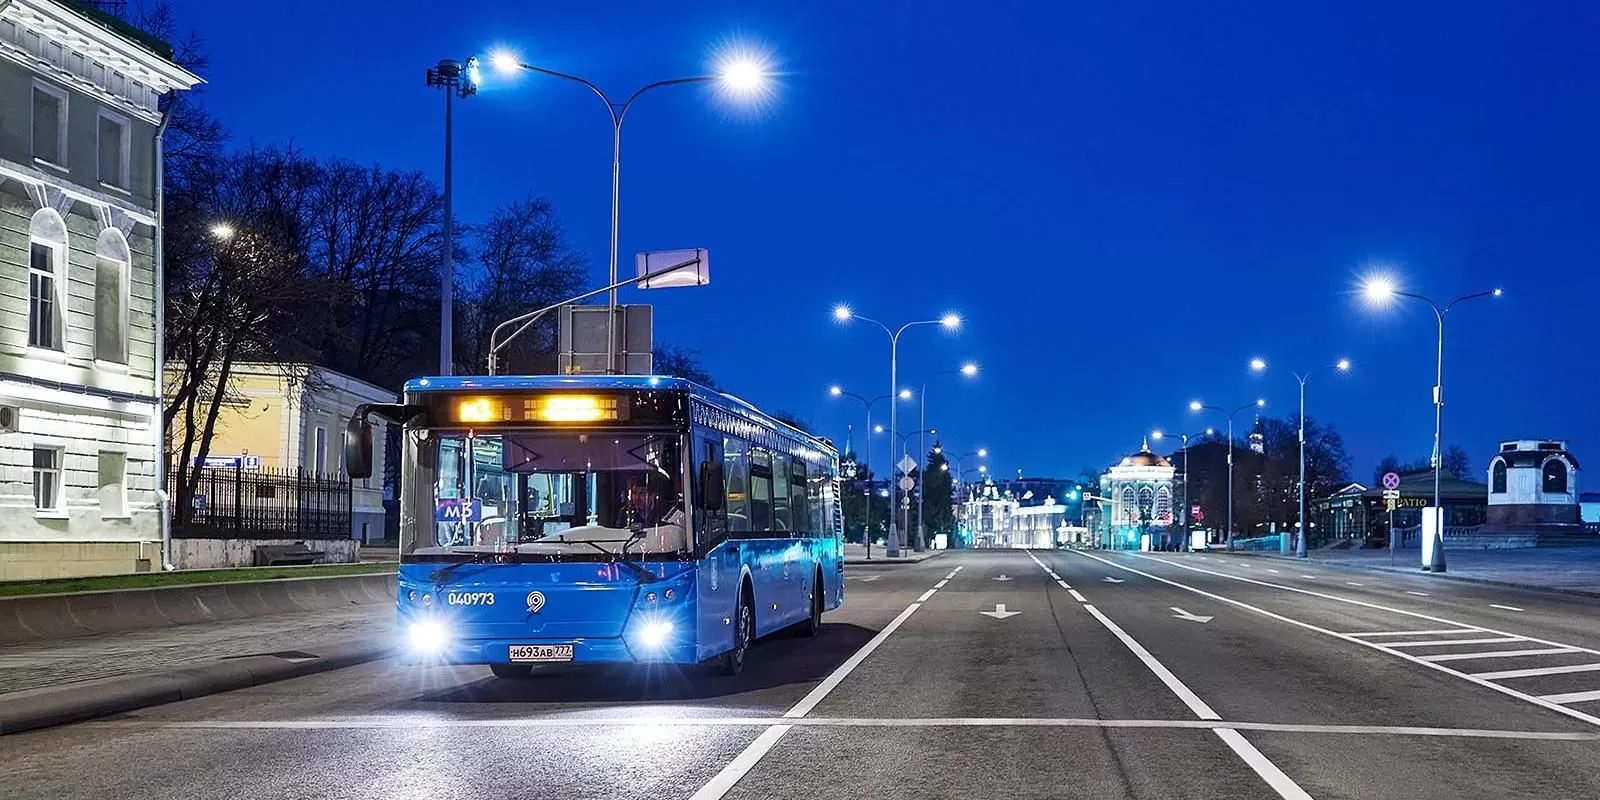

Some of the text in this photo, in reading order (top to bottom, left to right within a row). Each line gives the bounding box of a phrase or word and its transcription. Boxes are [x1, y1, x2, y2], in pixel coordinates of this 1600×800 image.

[1397, 498, 1427, 507] PATIO
[448, 592, 495, 605] 040973
[554, 645, 571, 654] 777
